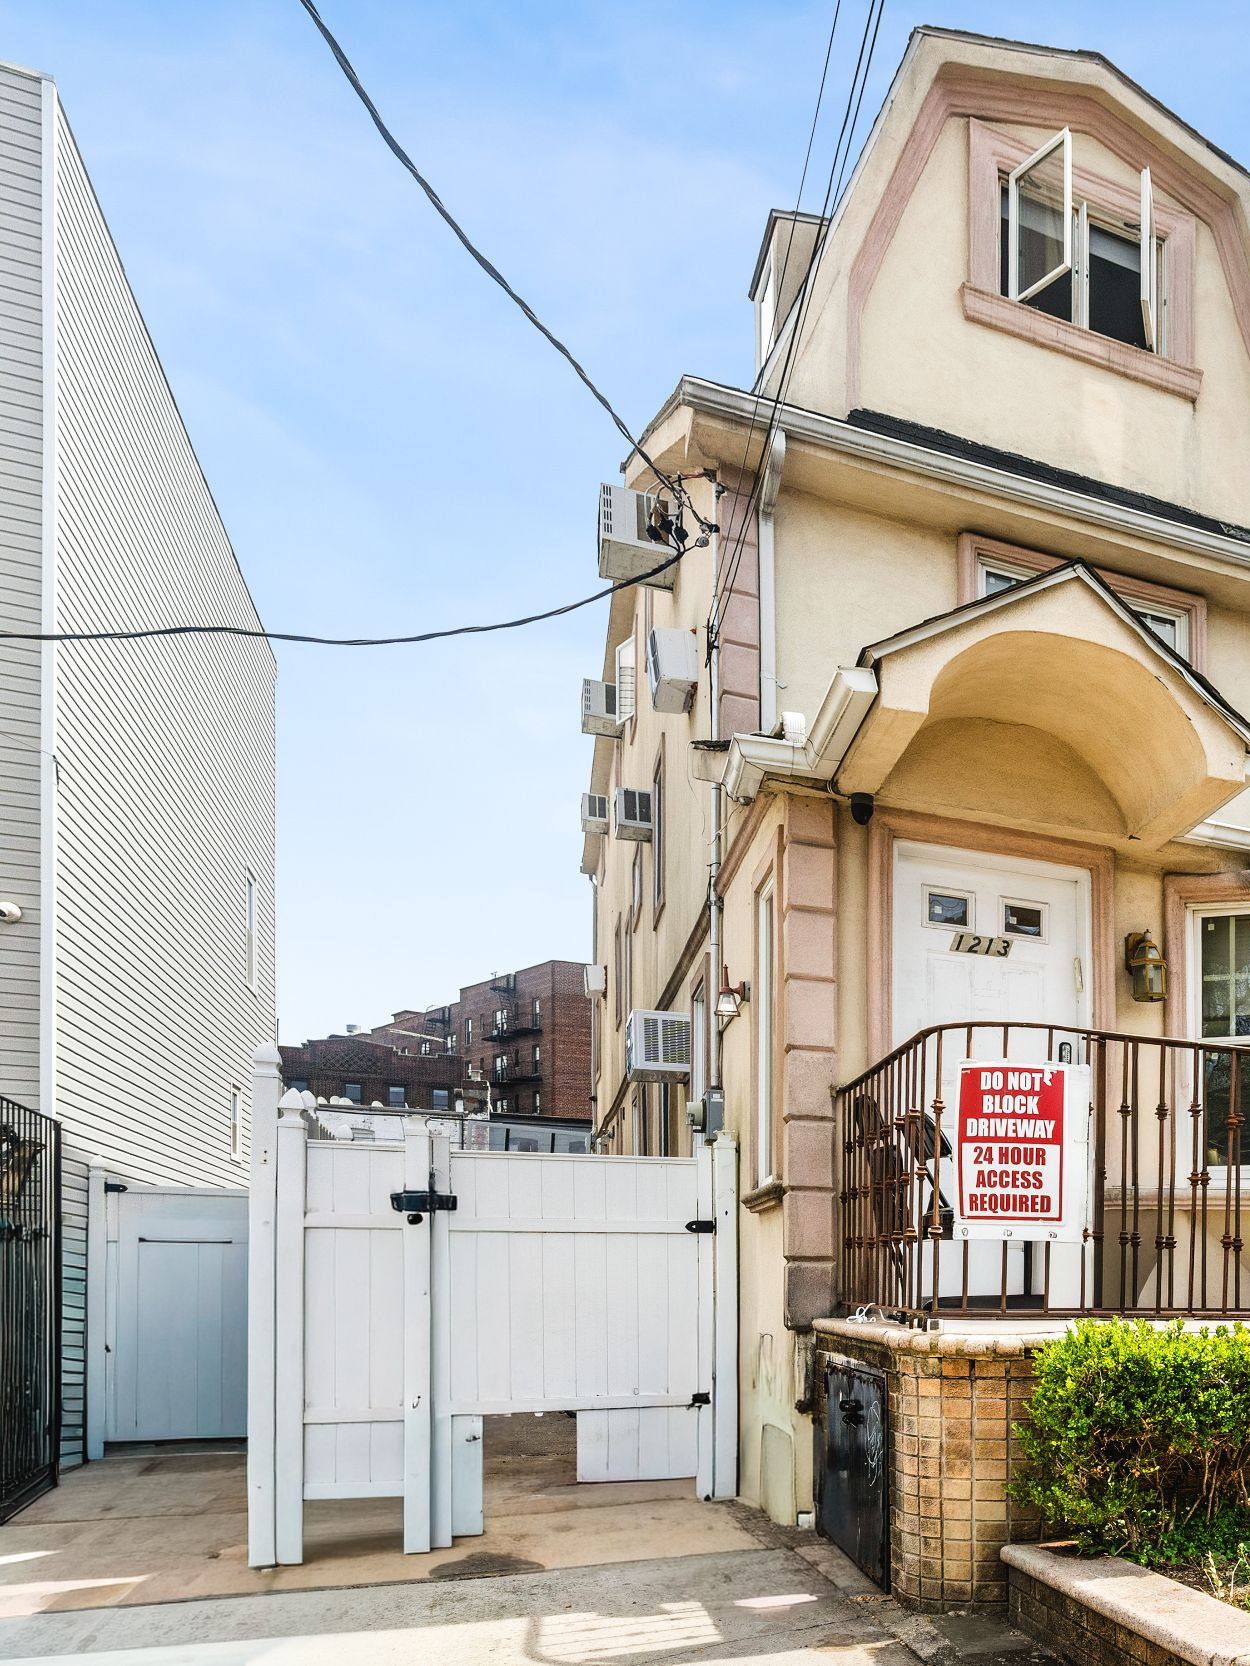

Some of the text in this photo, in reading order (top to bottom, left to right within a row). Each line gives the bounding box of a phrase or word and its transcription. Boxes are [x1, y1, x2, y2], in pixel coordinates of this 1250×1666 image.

[955, 934, 1010, 956] 1213
[980, 1071, 1043, 1092] DO NOT
[982, 1094, 1039, 1115] BLOCK
[966, 1118, 1056, 1139] DRIVEWAY
[973, 1146, 1047, 1166] 24 HOUR
[975, 1169, 1044, 1190] ACCESS
[968, 1193, 1051, 1214] REQUIRED
